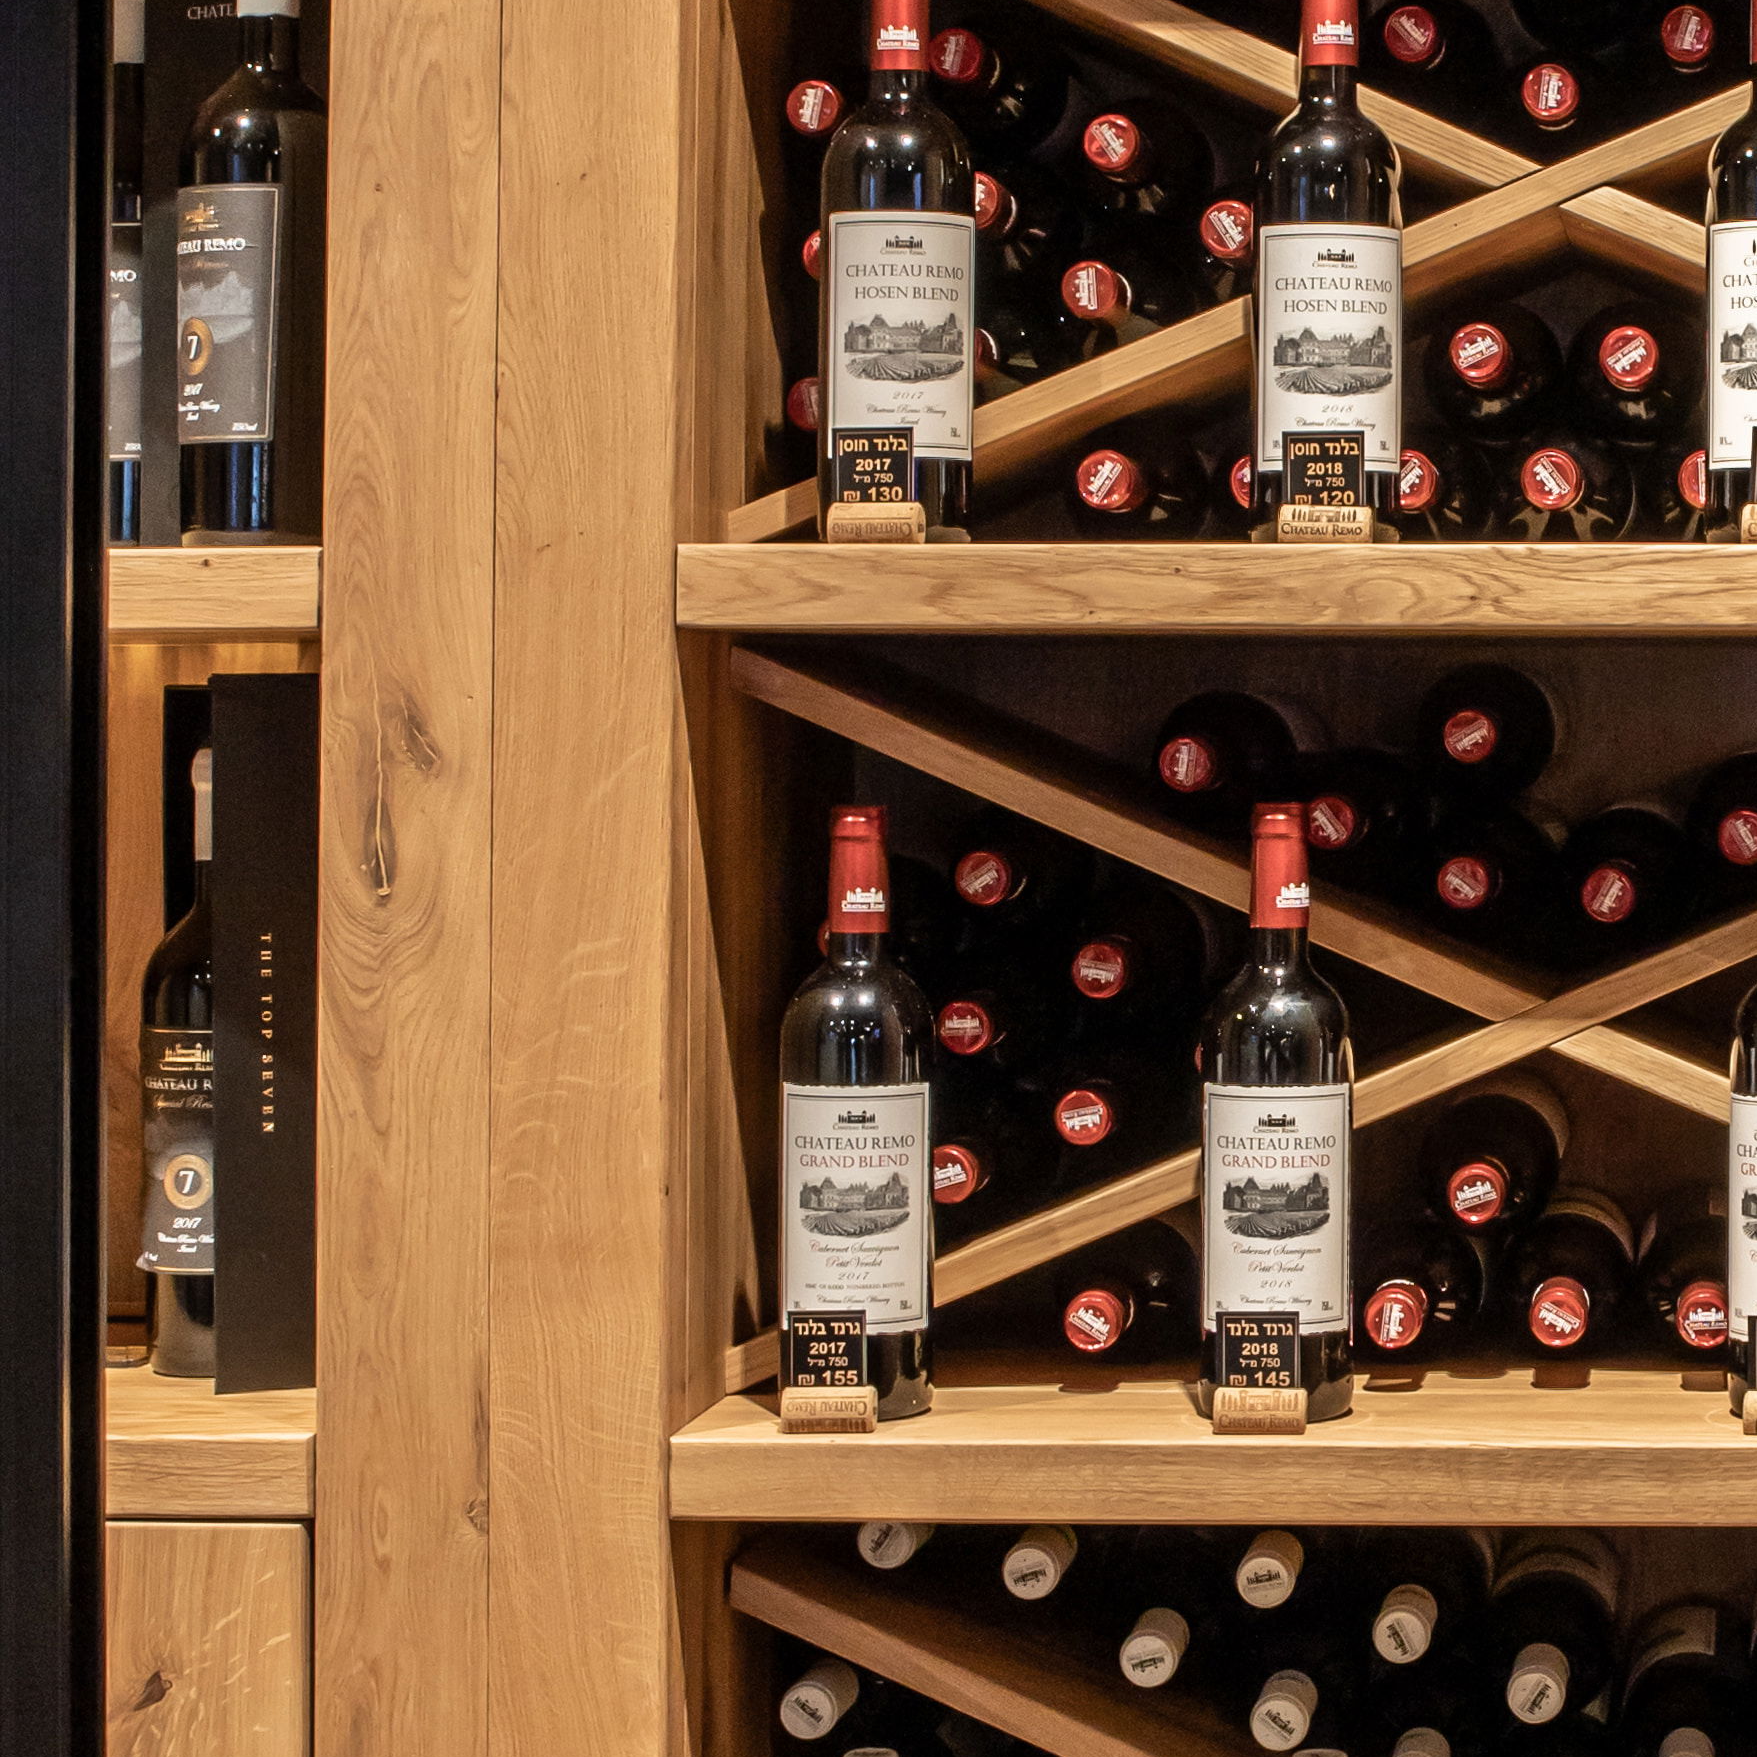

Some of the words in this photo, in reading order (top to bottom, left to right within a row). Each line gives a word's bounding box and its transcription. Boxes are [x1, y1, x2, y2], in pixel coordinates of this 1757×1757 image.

[845, 263, 922, 278] CHATEAU
[926, 266, 964, 281] REMO
[1275, 277, 1350, 291] CHATEAU
[1355, 278, 1392, 293] REMO
[855, 286, 908, 300] HOSEN
[913, 287, 959, 302] BLEND
[1284, 299, 1337, 313] HOSEN
[1342, 300, 1388, 315] BLEND
[187, 335, 198, 360] 7
[839, 438, 869, 456] חוסן
[873, 435, 908, 451] בלנד
[1290, 442, 1320, 459] חוסן
[1325, 438, 1360, 455] בלנד
[855, 458, 892, 472] 2017
[1306, 462, 1343, 475] 2018
[867, 486, 903, 502] 130
[1319, 490, 1355, 505] 120
[261, 933, 272, 978] THE
[261, 994, 273, 1039] TOP
[262, 1054, 275, 1132] SEVEN
[795, 1135, 867, 1150] CHATEAU
[872, 1135, 915, 1149] REMO
[1217, 1135, 1289, 1150] CHATEAU
[1294, 1135, 1336, 1150] REMO
[800, 1154, 855, 1168] GRAND
[858, 1154, 909, 1168] BLEND
[1222, 1154, 1277, 1169] GRAND
[1281, 1154, 1331, 1168] BLEND
[178, 1170, 194, 1194] 7
[794, 1319, 827, 1336] בלנד
[831, 1322, 861, 1335] גרנד
[1227, 1319, 1259, 1336] בלנד
[1263, 1322, 1293, 1336] גרנד
[809, 1342, 846, 1355] 2017
[1241, 1343, 1279, 1356] 2018
[822, 1370, 858, 1385] 155
[1254, 1371, 1291, 1386] 145
